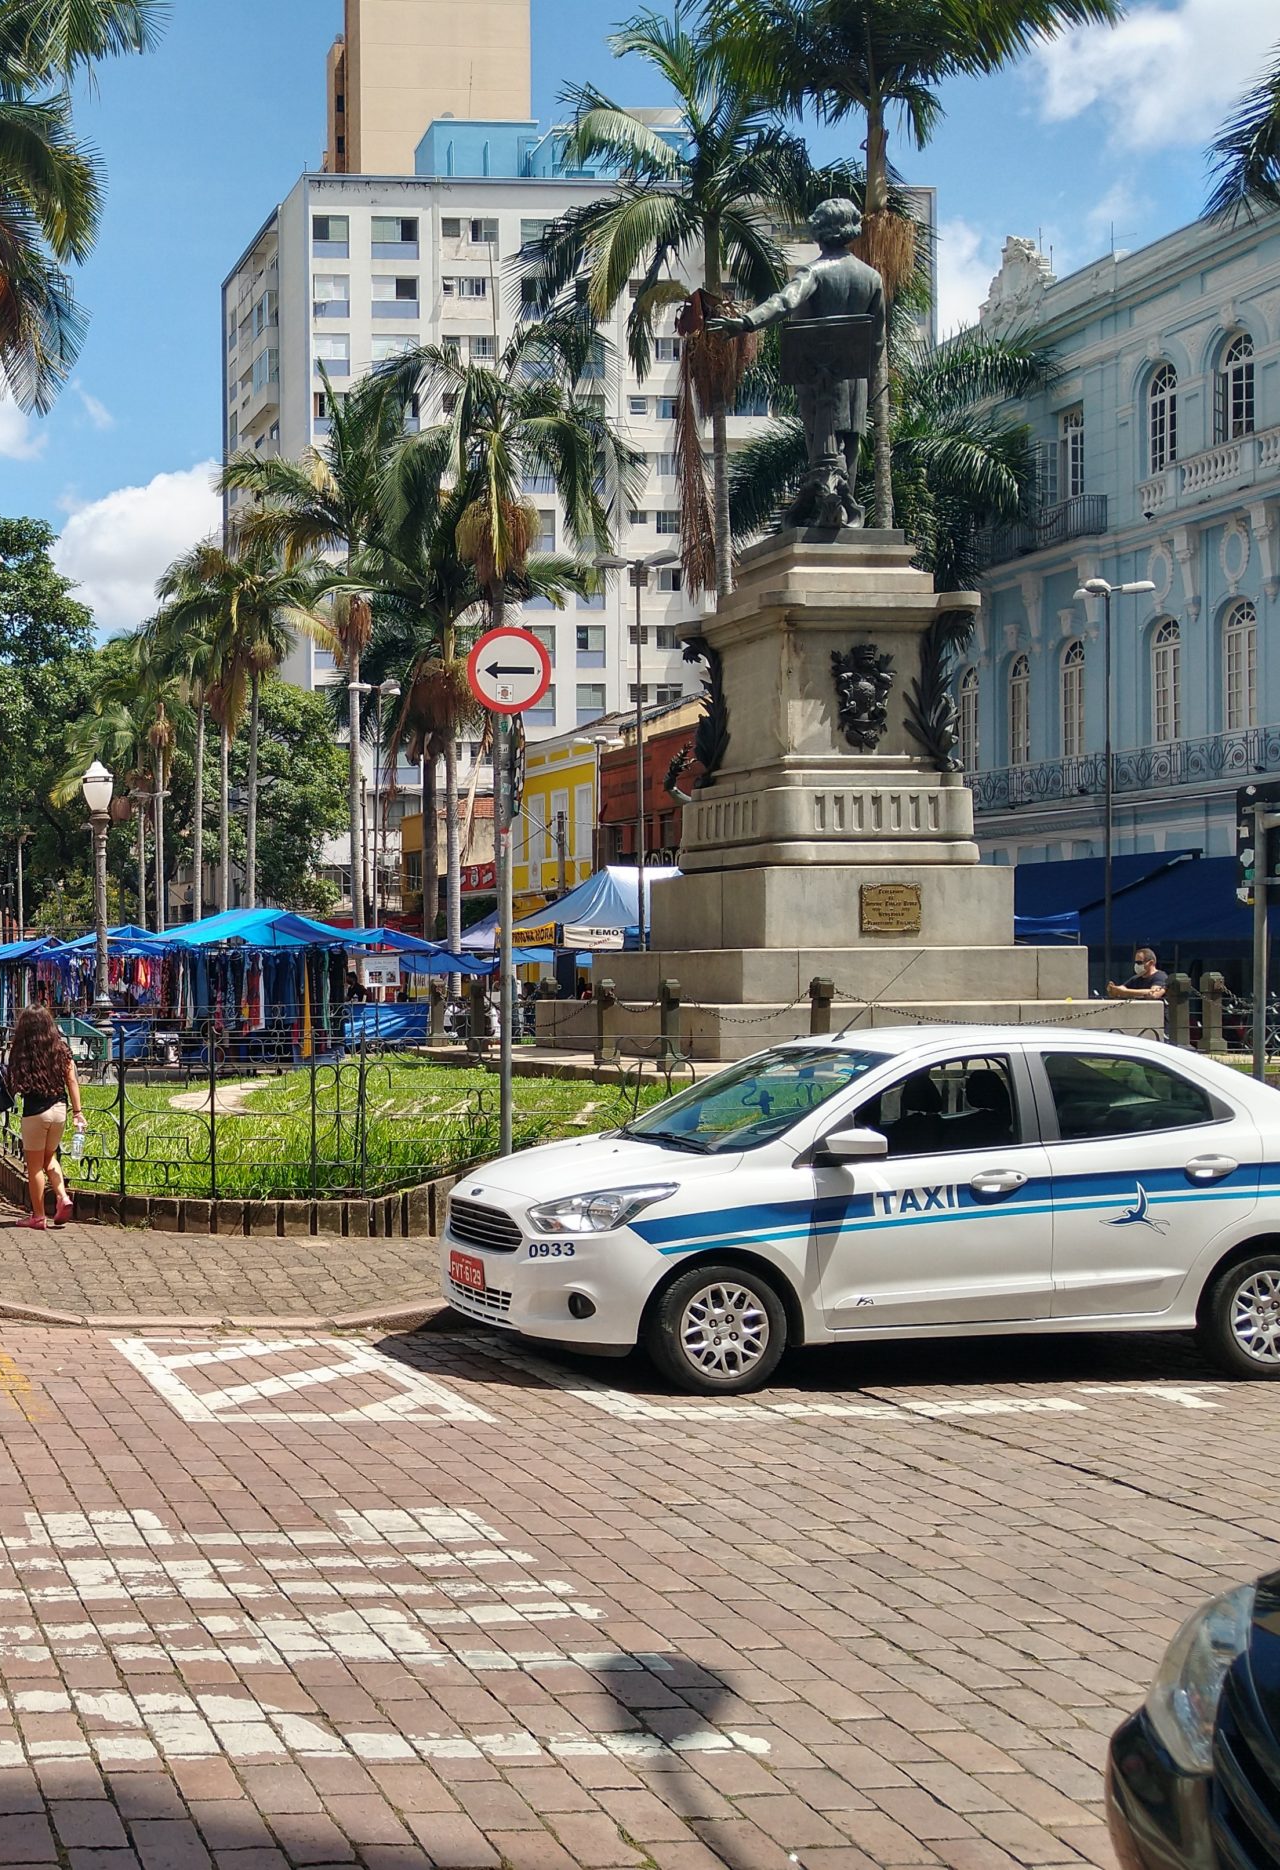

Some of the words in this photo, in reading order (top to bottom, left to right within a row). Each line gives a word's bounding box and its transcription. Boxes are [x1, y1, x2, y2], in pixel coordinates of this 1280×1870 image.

[589, 928, 624, 936] TEMOS
[876, 1183, 956, 1215] TAXI
[528, 1242, 575, 1258] 0933
